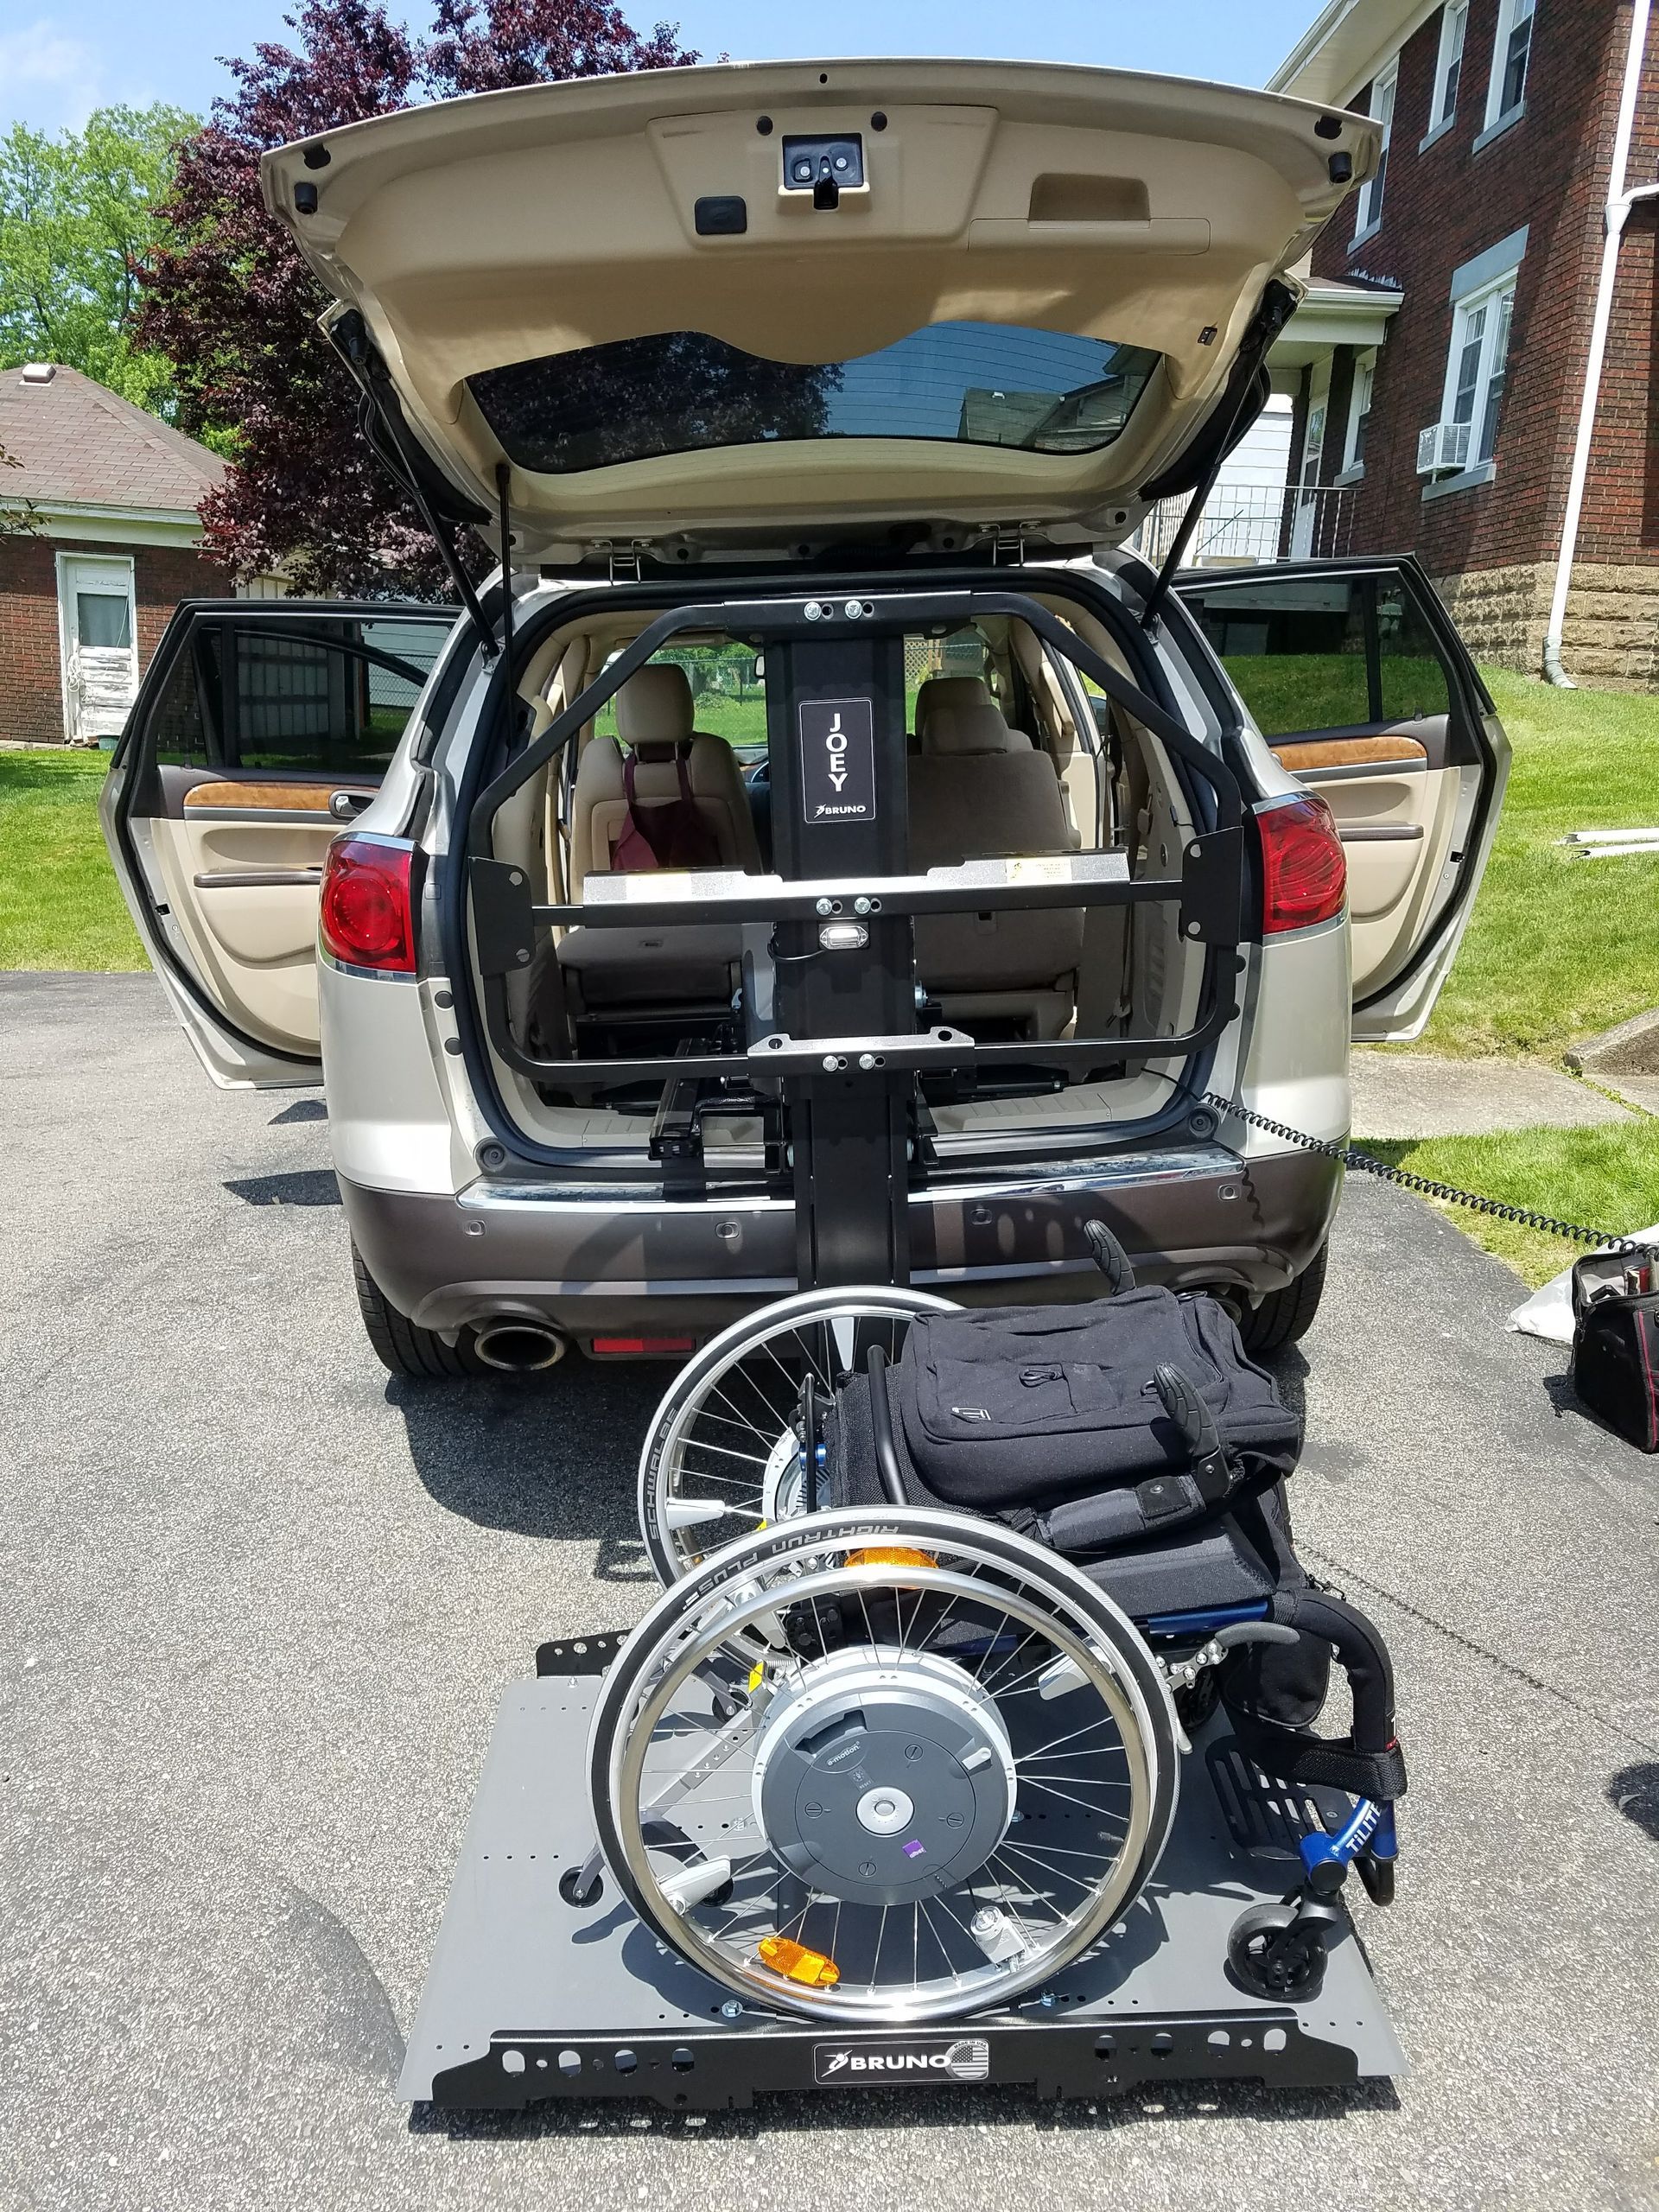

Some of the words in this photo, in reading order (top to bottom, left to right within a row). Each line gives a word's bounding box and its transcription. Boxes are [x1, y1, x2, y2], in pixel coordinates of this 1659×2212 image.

[826, 713, 848, 792] JOEY
[825, 805, 867, 815] BRUNO
[646, 1407, 678, 1539] SCHWALBE
[772, 1525, 899, 1554] RIGHTRUN
[698, 1553, 759, 1596] PLUS
[850, 2055, 951, 2070] BRUNO
